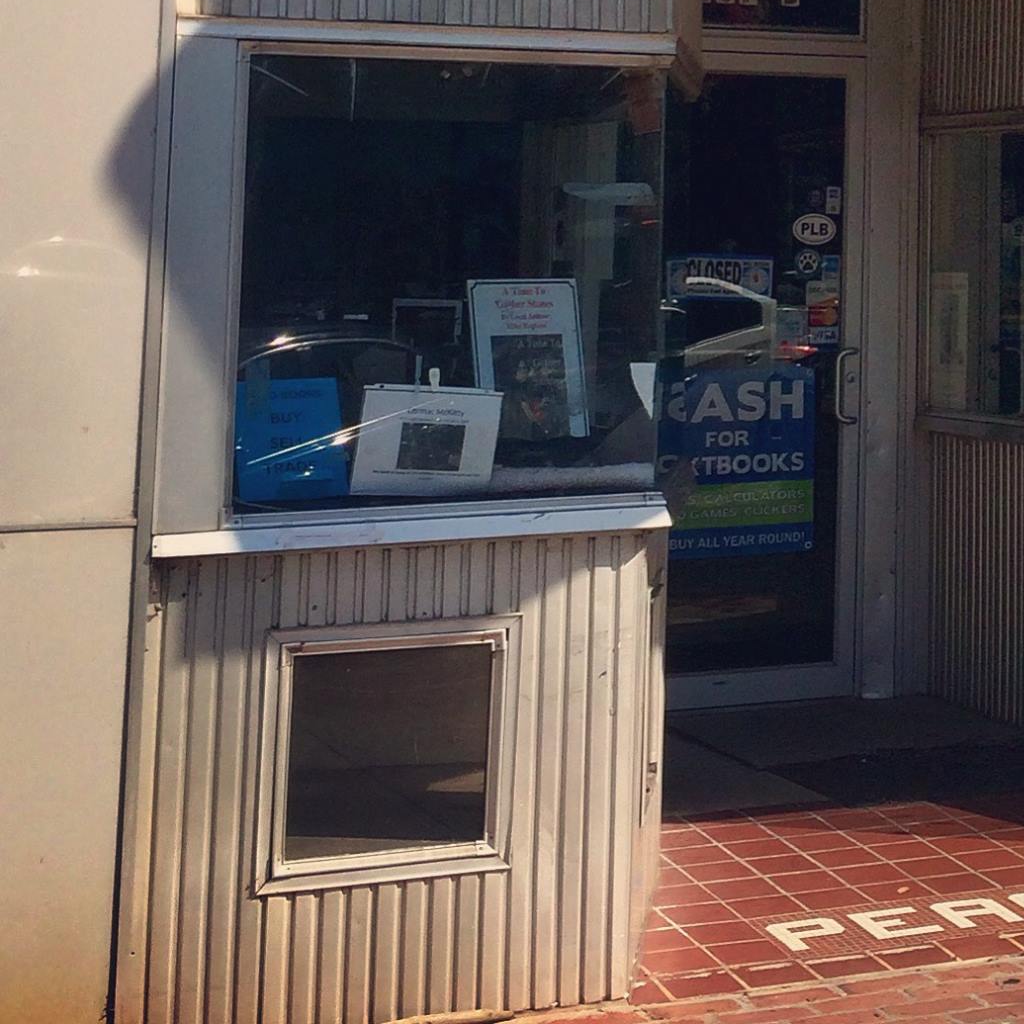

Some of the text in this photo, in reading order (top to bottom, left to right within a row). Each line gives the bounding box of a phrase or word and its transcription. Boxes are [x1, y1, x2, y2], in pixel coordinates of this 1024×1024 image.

[801, 222, 829, 236] PLB
[687, 259, 742, 286] CLOSED
[672, 379, 805, 424] ASH
[270, 411, 303, 424] BUY
[705, 430, 750, 448] FOR
[690, 452, 805, 476] TBOOKS
[704, 488, 806, 505] CALCULATORS
[690, 507, 737, 519] GAMES
[669, 531, 806, 551] BUY ALL YEAR ROUND!
